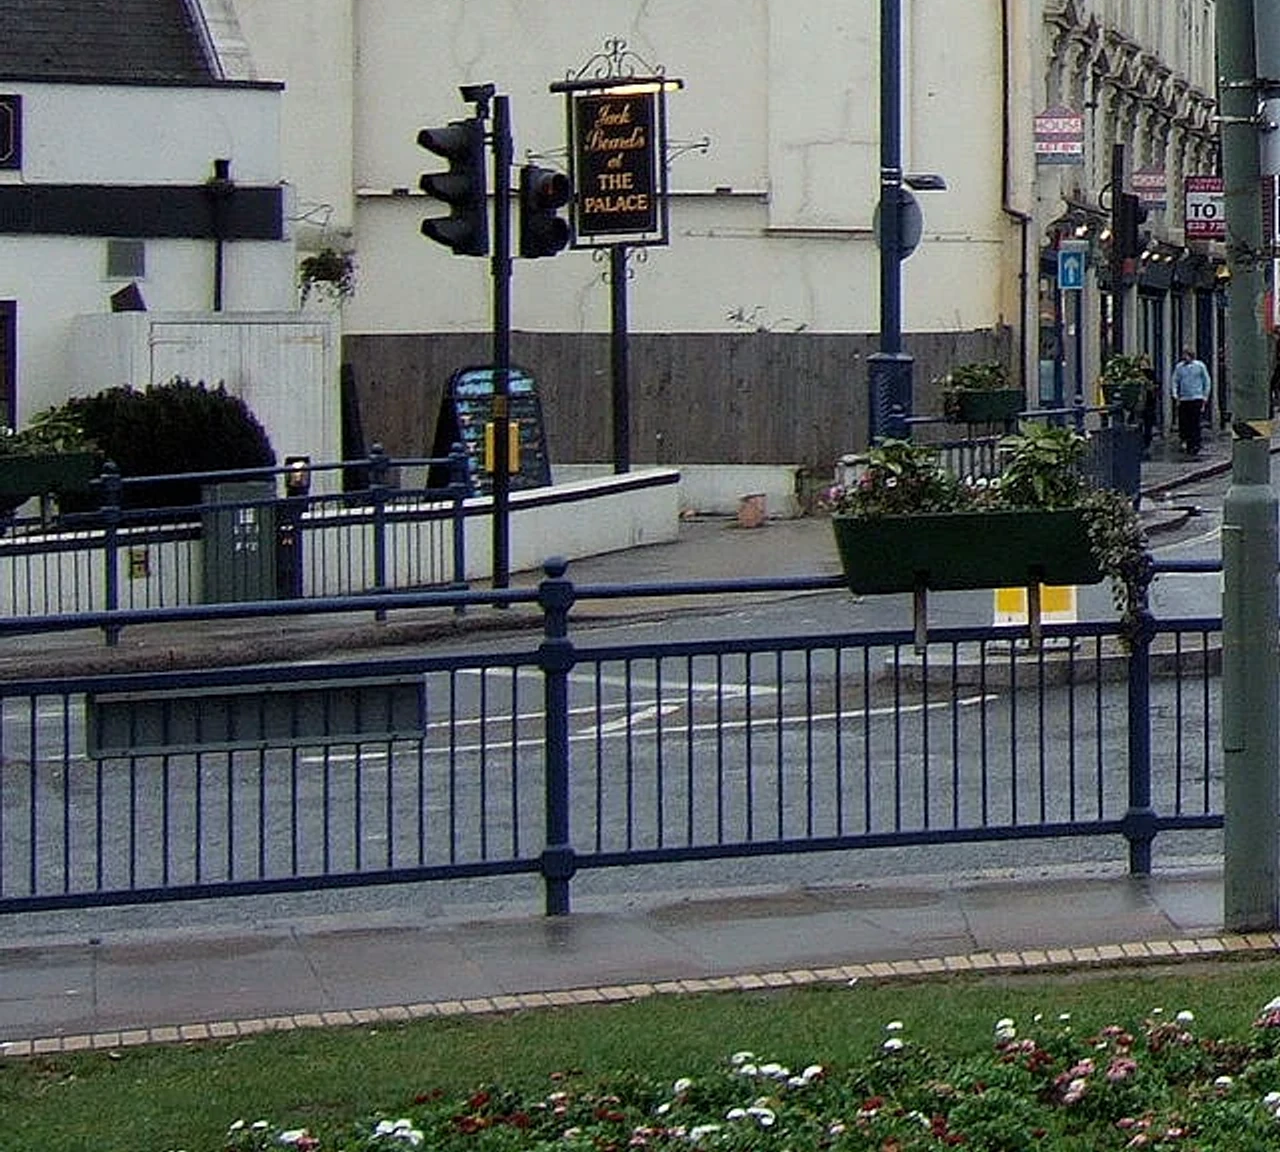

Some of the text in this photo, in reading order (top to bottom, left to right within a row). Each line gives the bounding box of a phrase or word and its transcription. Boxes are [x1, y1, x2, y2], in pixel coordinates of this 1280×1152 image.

[594, 103, 632, 127] Jack
[596, 171, 634, 191] THE
[583, 193, 649, 214] PALACE
[1190, 202, 1218, 219] TO
